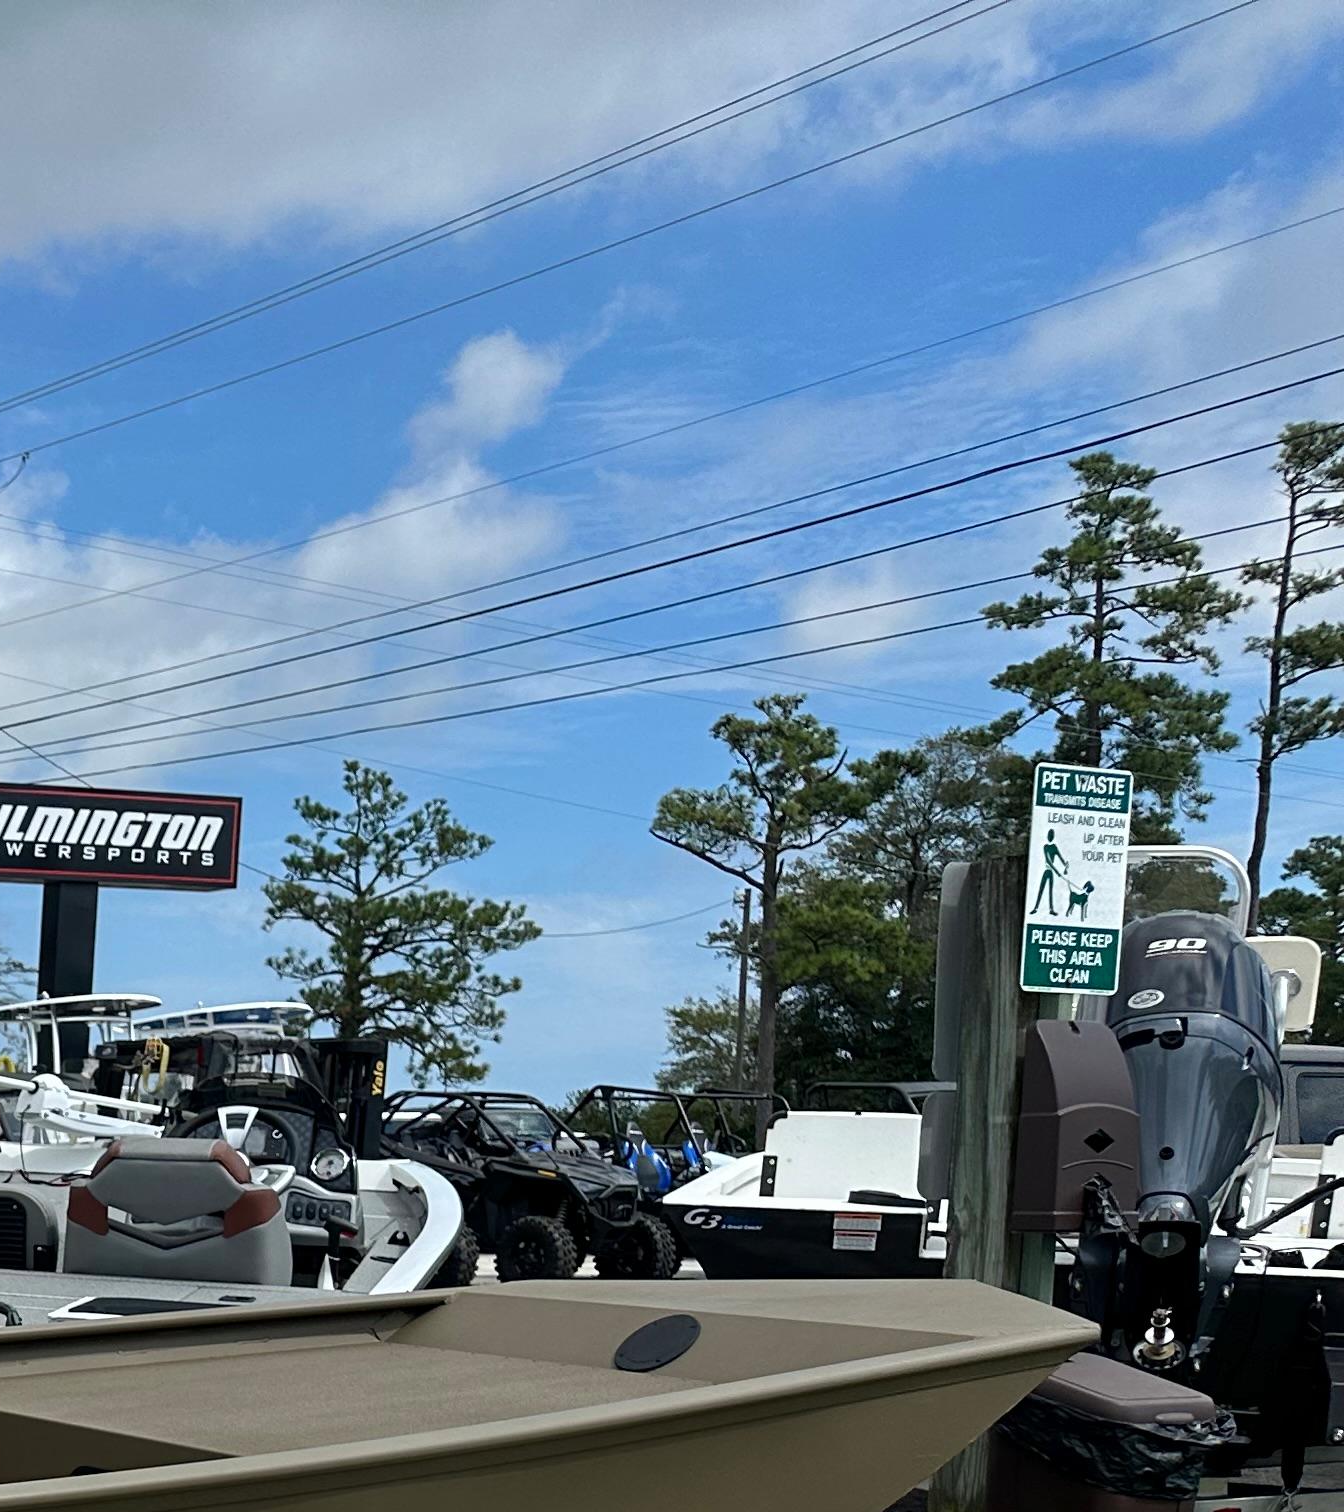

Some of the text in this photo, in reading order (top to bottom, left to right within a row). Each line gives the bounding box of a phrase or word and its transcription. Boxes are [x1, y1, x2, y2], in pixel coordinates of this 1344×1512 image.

[1041, 770, 1126, 796] PET WASTE
[1087, 797, 1123, 810] DISEASE
[1047, 812, 1126, 829] LEASH AND CLEAN
[1083, 832, 1125, 846] UP AFTER
[1082, 850, 1123, 864] YOUR PET
[1031, 929, 1113, 949] PLEASE KEEP
[1146, 937, 1208, 954] 90
[1038, 948, 1103, 967] THIS AREA
[1049, 966, 1090, 984] CLEAN
[683, 1207, 722, 1230] G3
